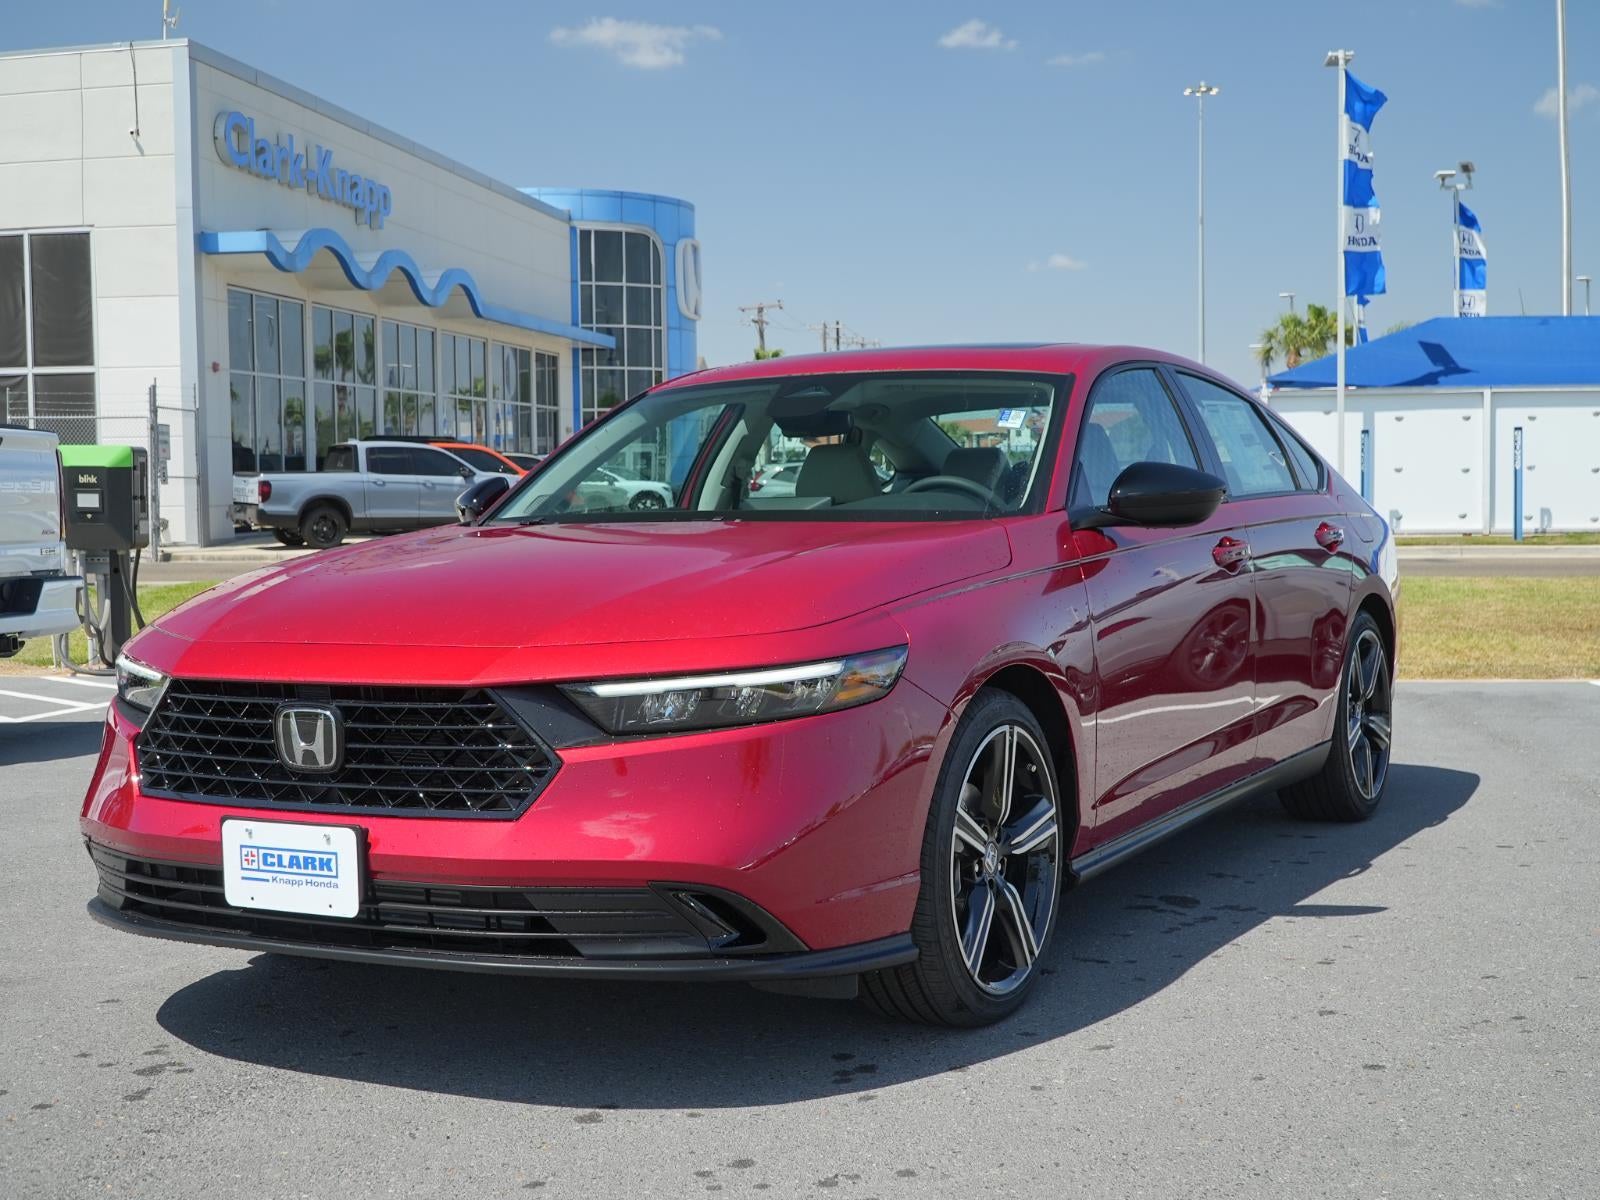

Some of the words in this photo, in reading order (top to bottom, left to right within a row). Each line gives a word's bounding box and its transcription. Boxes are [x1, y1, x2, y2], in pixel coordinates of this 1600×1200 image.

[219, 111, 391, 230] Clark-Knapp
[78, 474, 98, 484] blink
[262, 852, 333, 872] CLARK
[271, 876, 304, 888] Knapp
[305, 879, 339, 889] Honda
